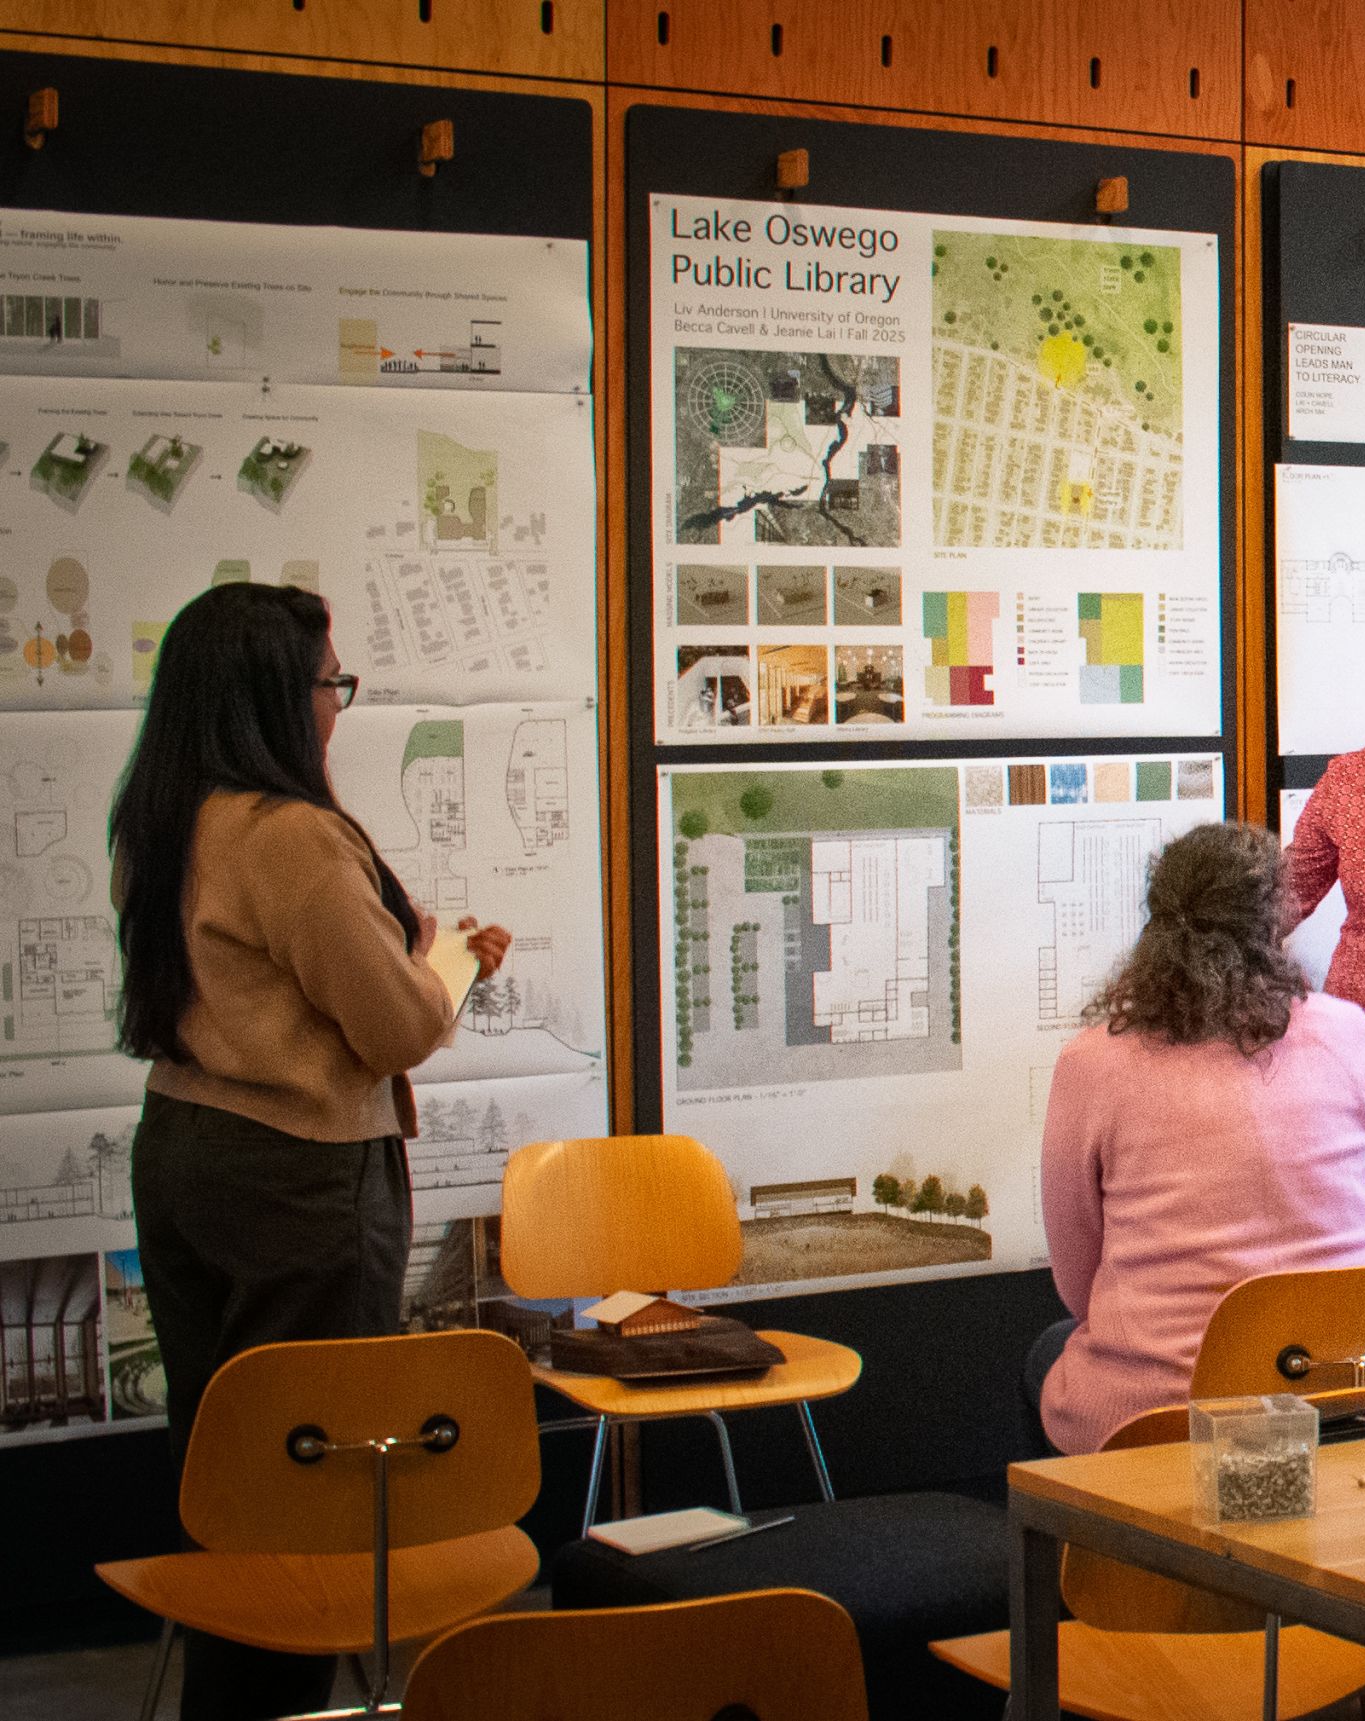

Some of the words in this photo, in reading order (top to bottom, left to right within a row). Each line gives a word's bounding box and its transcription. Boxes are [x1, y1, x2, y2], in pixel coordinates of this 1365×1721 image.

[21, 230, 64, 241] framing
[67, 231, 83, 240] life
[672, 208, 751, 243] Lake
[765, 214, 899, 258] Oswego
[672, 255, 772, 290] Public
[786, 261, 900, 303] Library
[674, 303, 692, 314] Liv
[698, 305, 759, 318] Anderson
[770, 308, 834, 325] University
[838, 312, 851, 323] of
[855, 313, 900, 327] Oregon
[674, 320, 713, 332] Becca
[717, 321, 755, 335] Cavell
[759, 324, 769, 336] &
[773, 324, 813, 338] Jeanie
[818, 327, 836, 339] Lai
[847, 329, 868, 341] Fall
[872, 331, 906, 343] 2025
[1295, 331, 1347, 342] CIRCULAR
[1295, 344, 1342, 356] OPENING
[1296, 358, 1329, 369] LEADS
[1331, 360, 1353, 370] MAN
[1296, 371, 1310, 381] TO
[1312, 372, 1361, 384] LITERACY
[676, 1097, 706, 1106] GROUND
